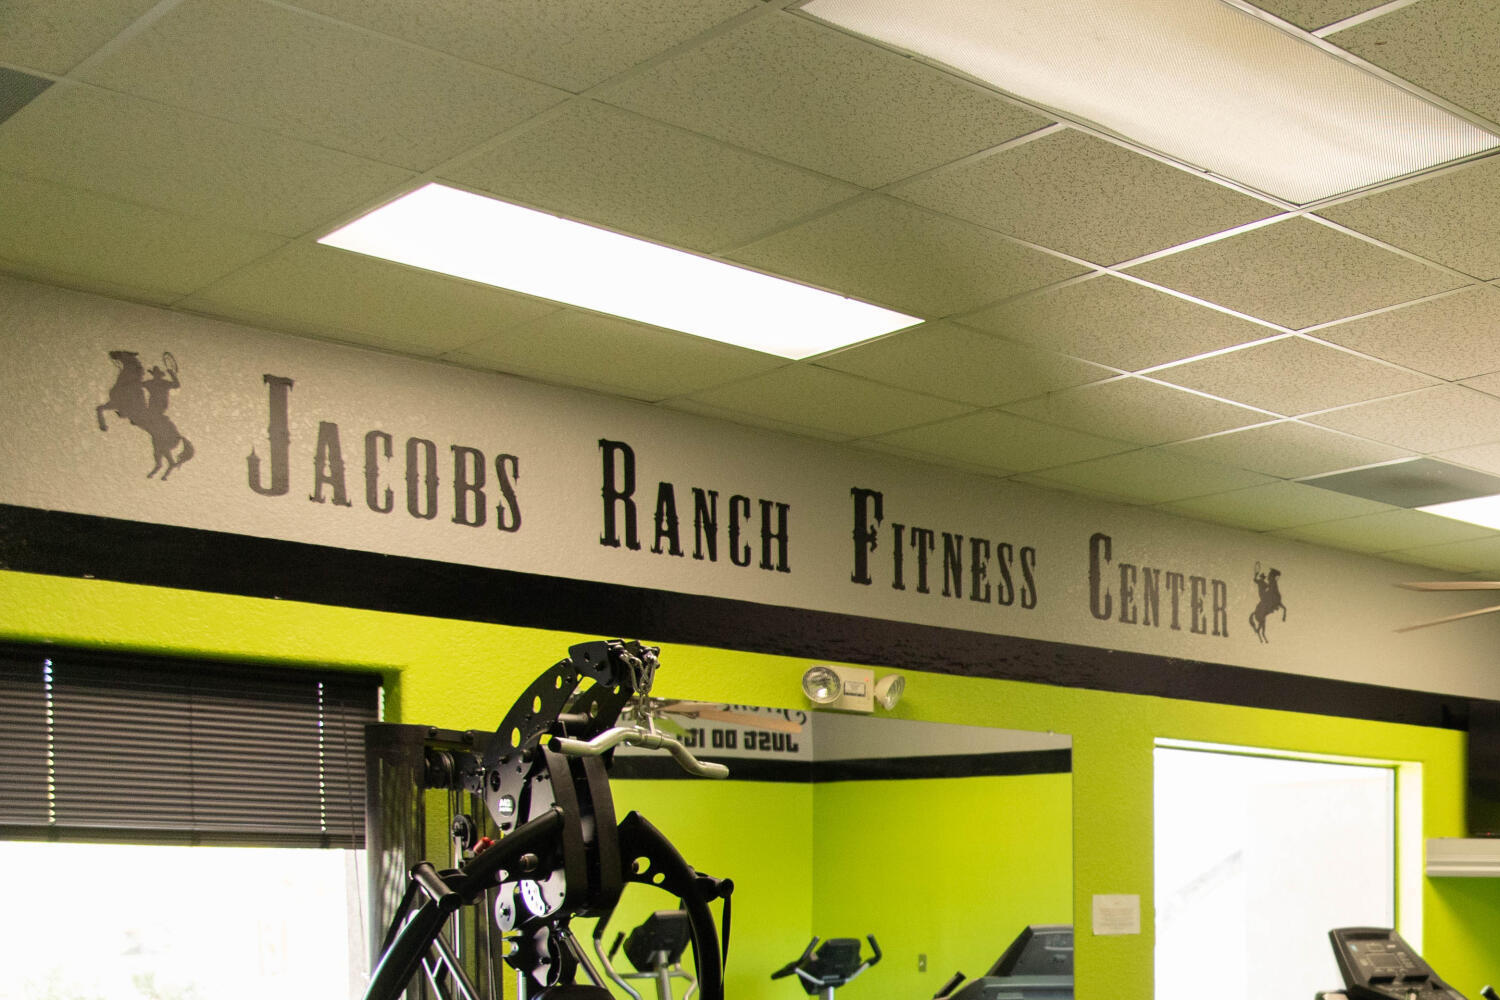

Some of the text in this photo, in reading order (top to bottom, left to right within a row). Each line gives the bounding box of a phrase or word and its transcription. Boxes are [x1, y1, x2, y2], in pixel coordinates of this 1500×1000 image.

[246, 374, 1229, 638] JACOBS RANCH FITNESS CENTER
